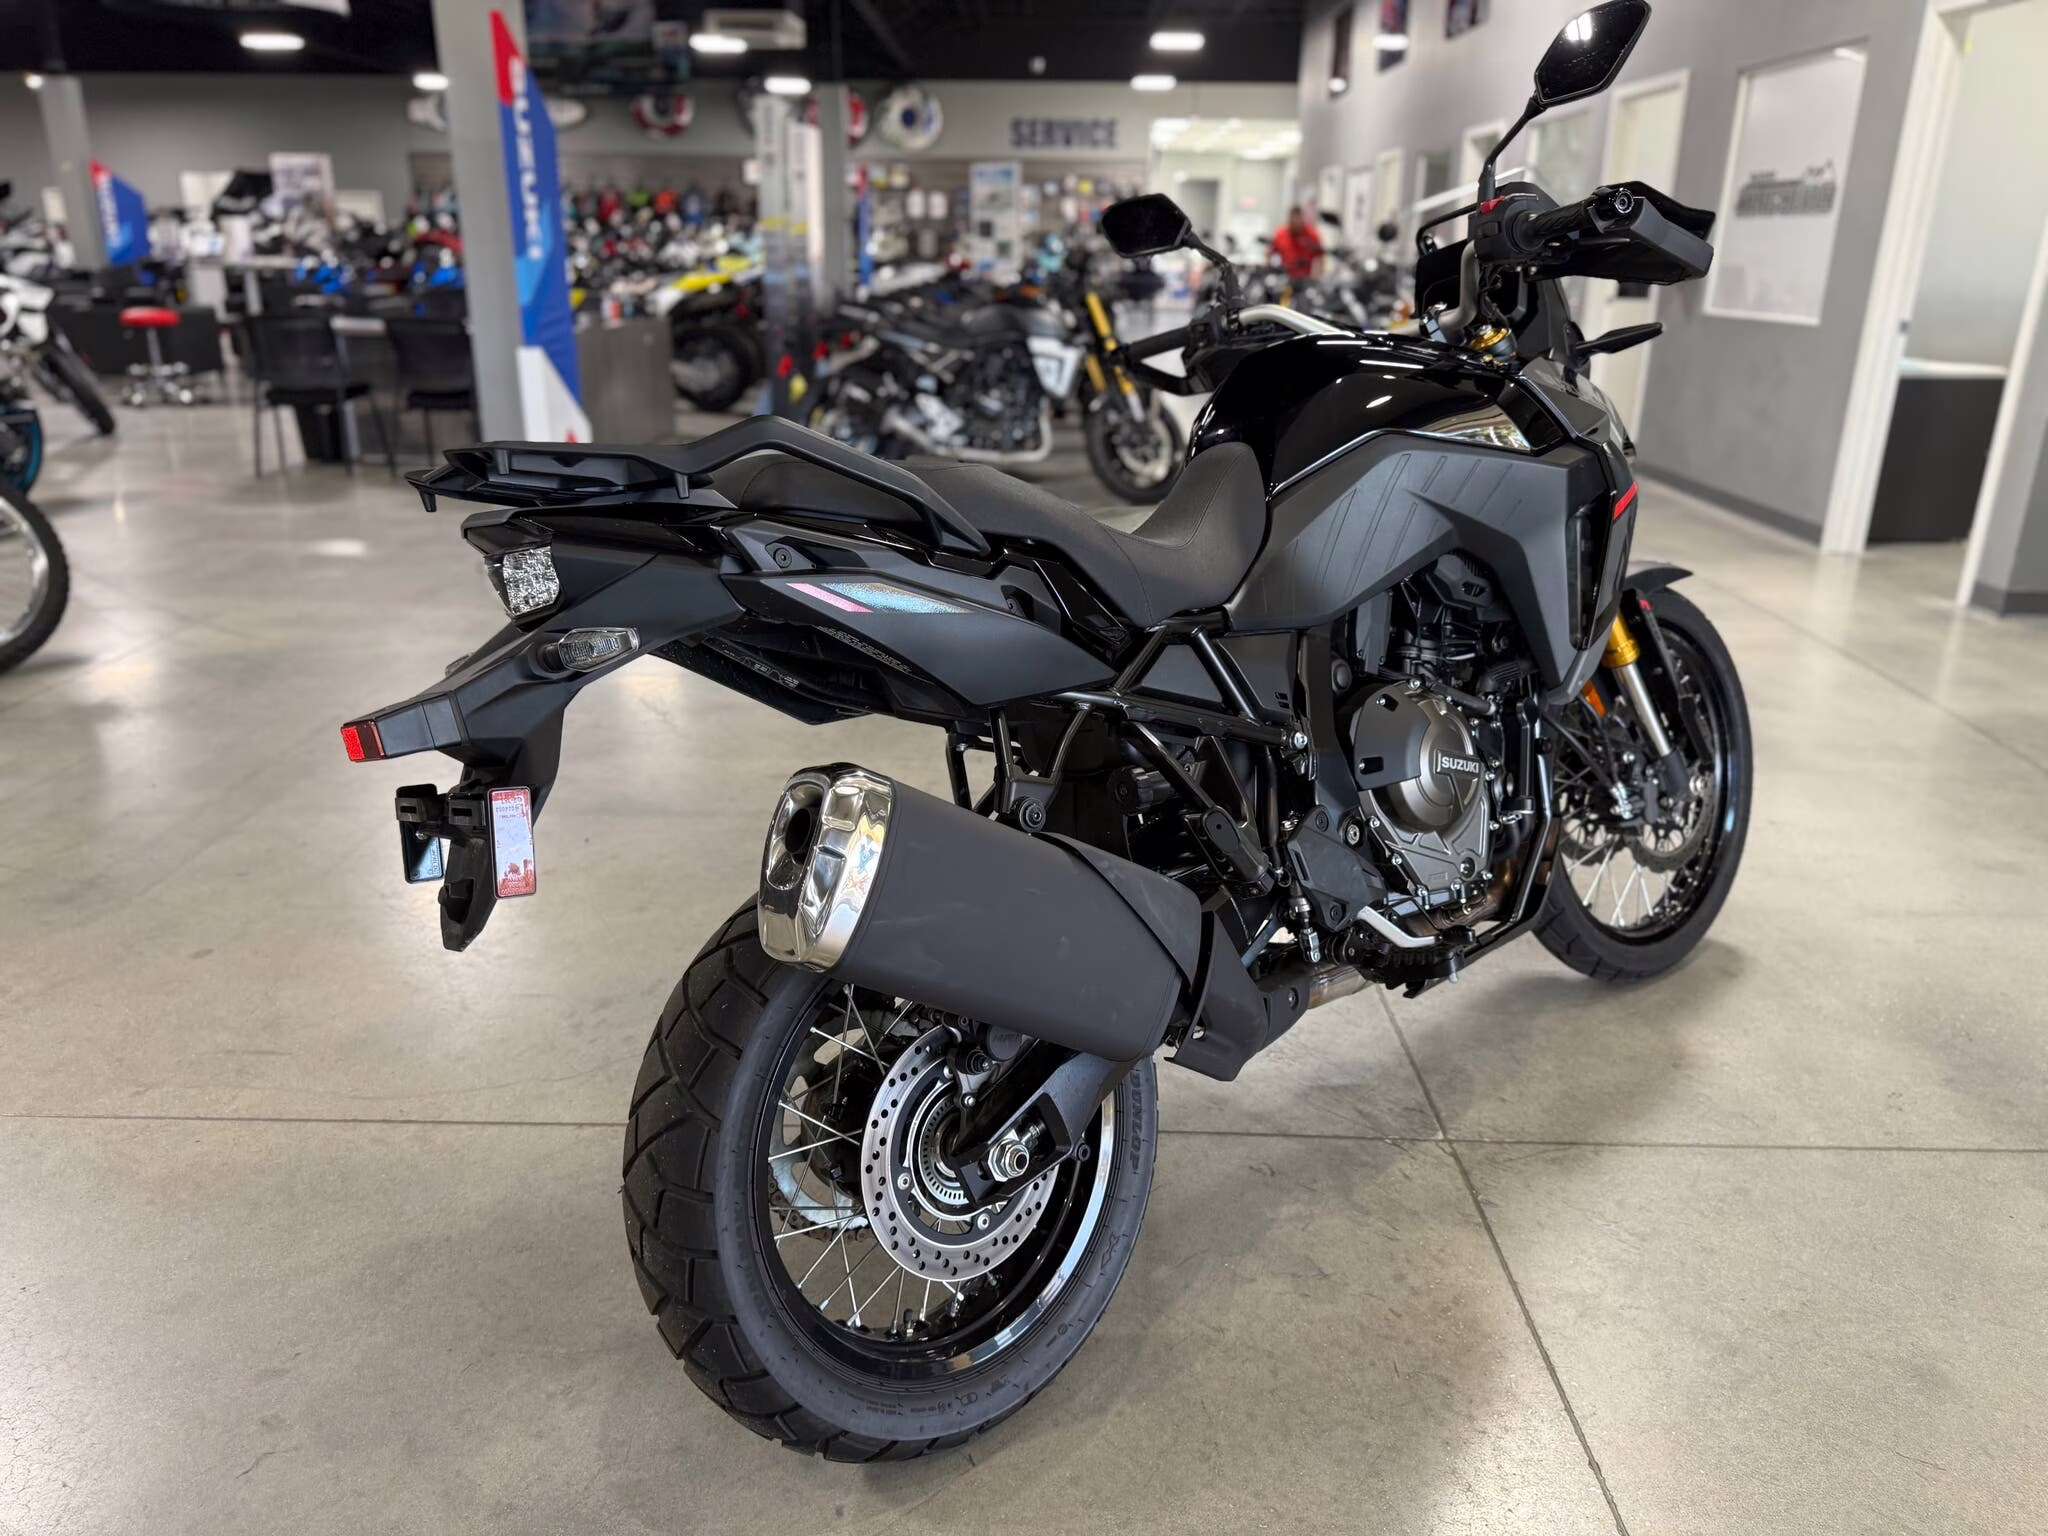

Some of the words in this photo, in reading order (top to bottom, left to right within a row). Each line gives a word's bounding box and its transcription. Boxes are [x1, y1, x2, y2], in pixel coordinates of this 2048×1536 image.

[1011, 118, 1117, 147] SERVICE
[1441, 756, 1479, 774] SUZUKI
[1129, 1072, 1143, 1171] DUNLOP
